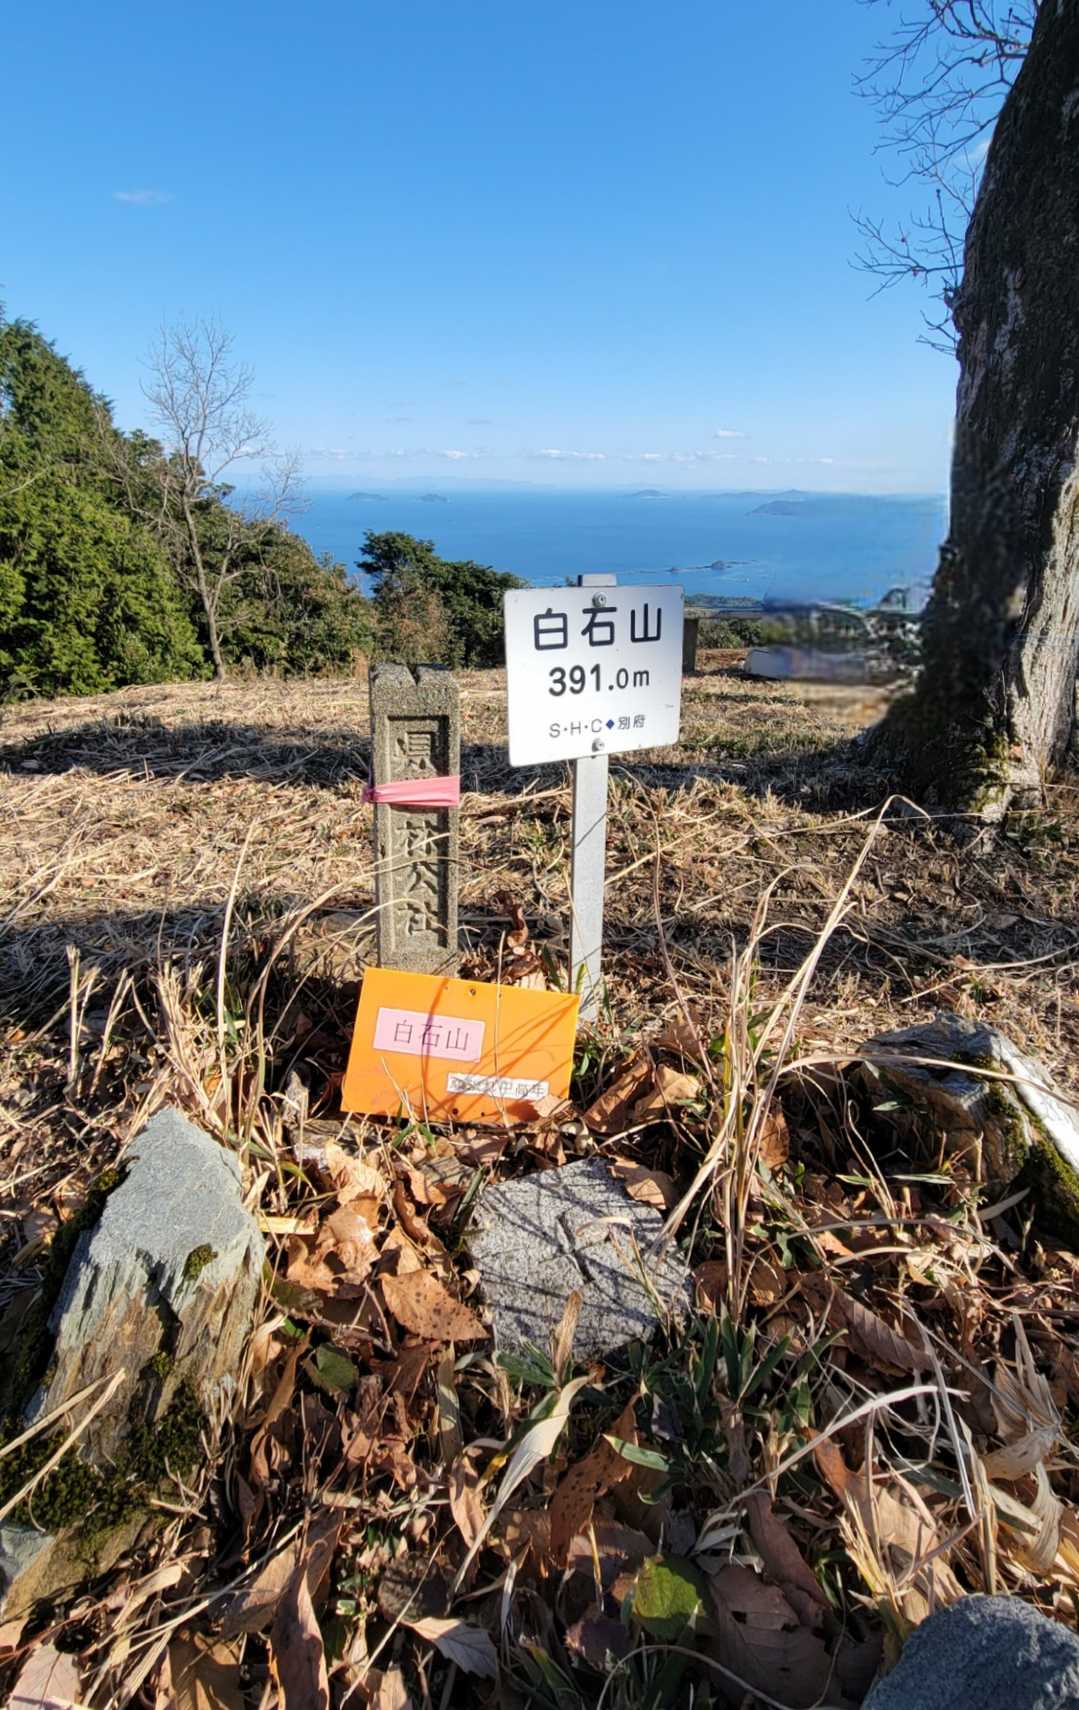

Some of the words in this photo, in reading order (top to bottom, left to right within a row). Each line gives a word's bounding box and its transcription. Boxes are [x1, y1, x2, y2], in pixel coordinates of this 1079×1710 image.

[533, 603, 662, 651] 白石山
[548, 663, 650, 697] 391.0m
[617, 714, 646, 730] 別府
[396, 731, 441, 938] 県林公社
[393, 1019, 470, 1052] 白石山
